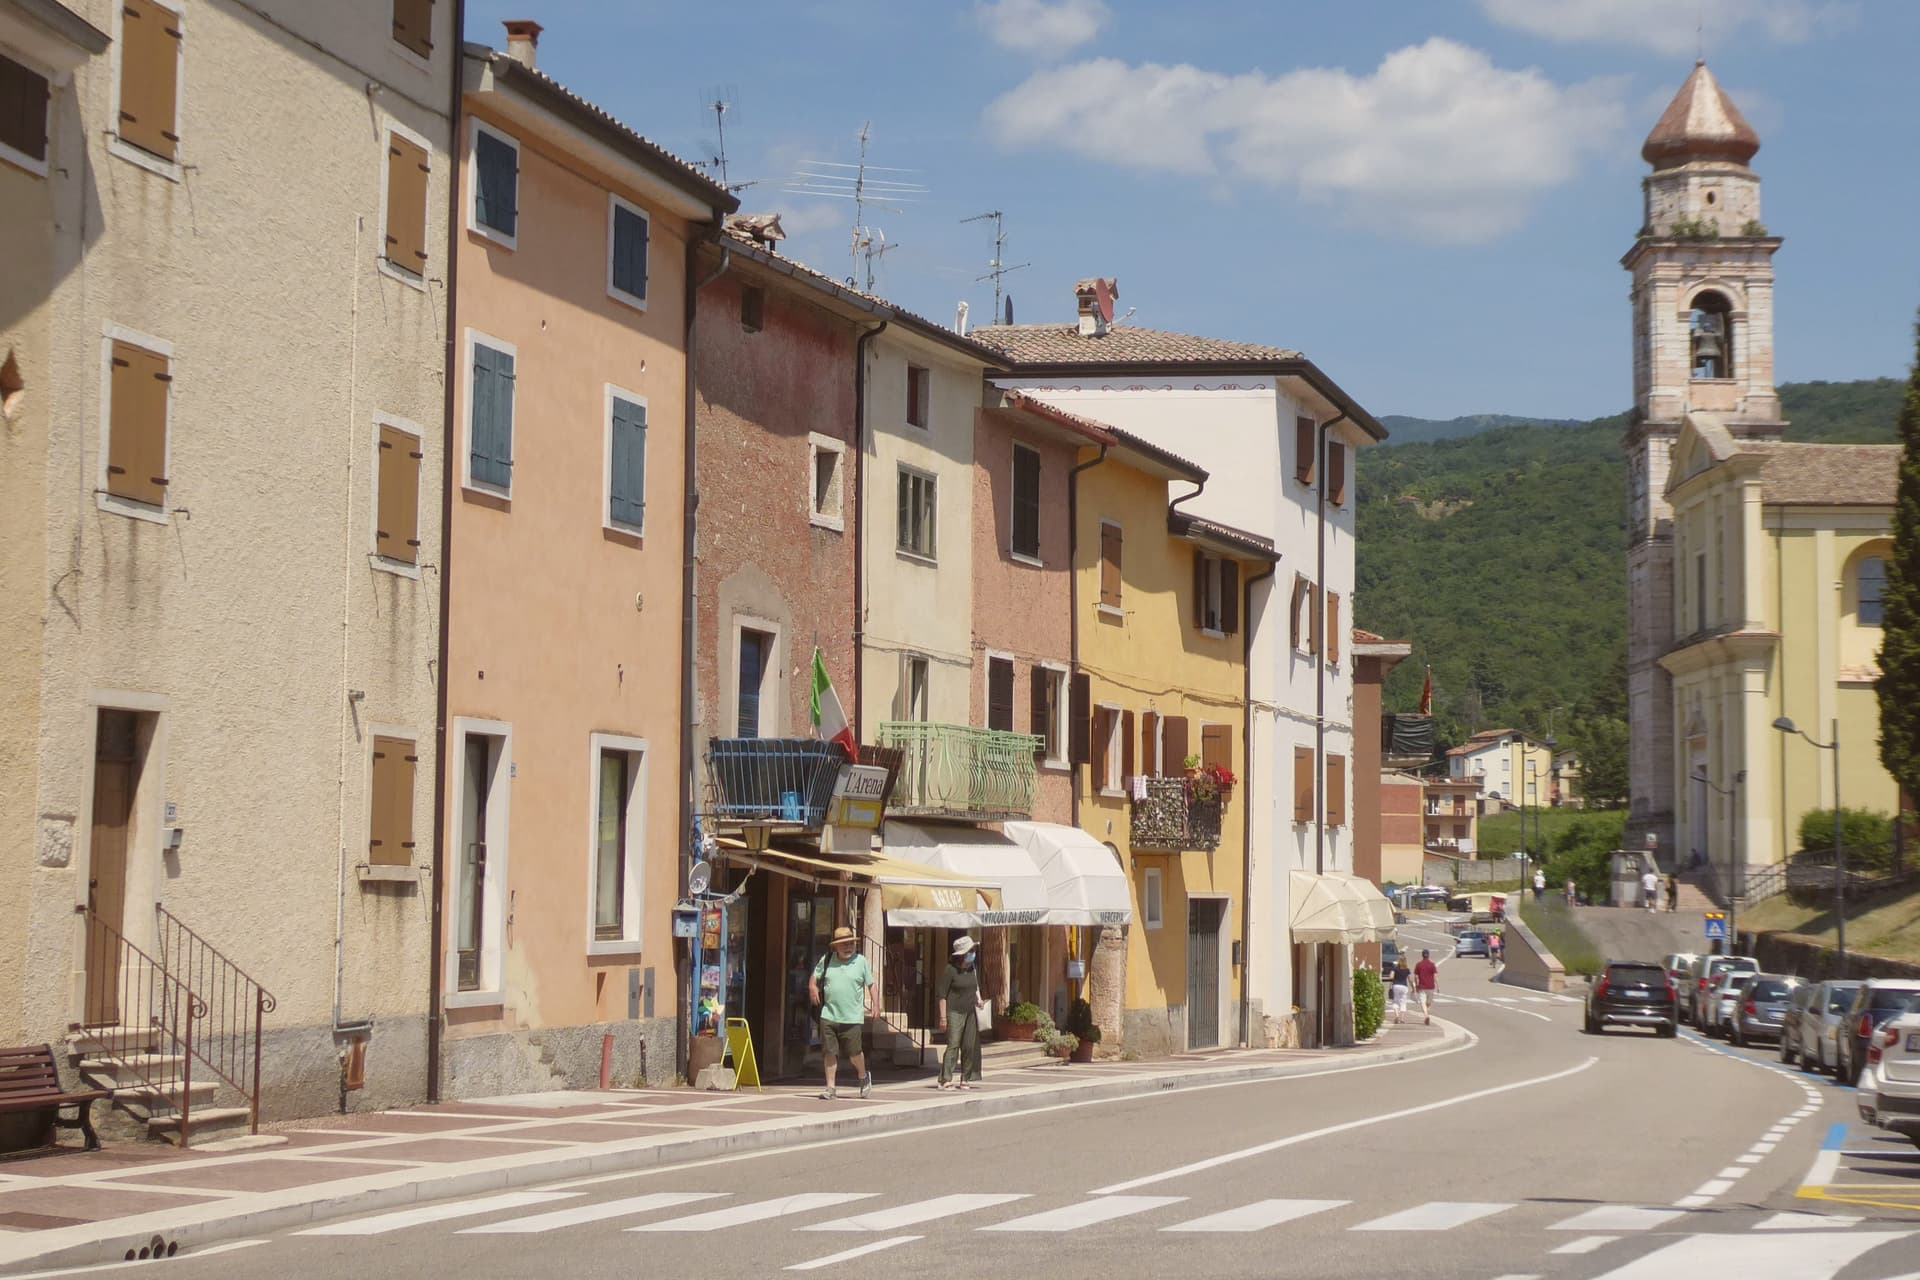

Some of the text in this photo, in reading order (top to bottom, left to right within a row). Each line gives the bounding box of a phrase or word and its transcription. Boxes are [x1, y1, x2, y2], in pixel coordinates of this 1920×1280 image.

[844, 772, 884, 795] L'Arena
[1008, 911, 1017, 924] DA
[1017, 910, 1040, 923] REGALO
